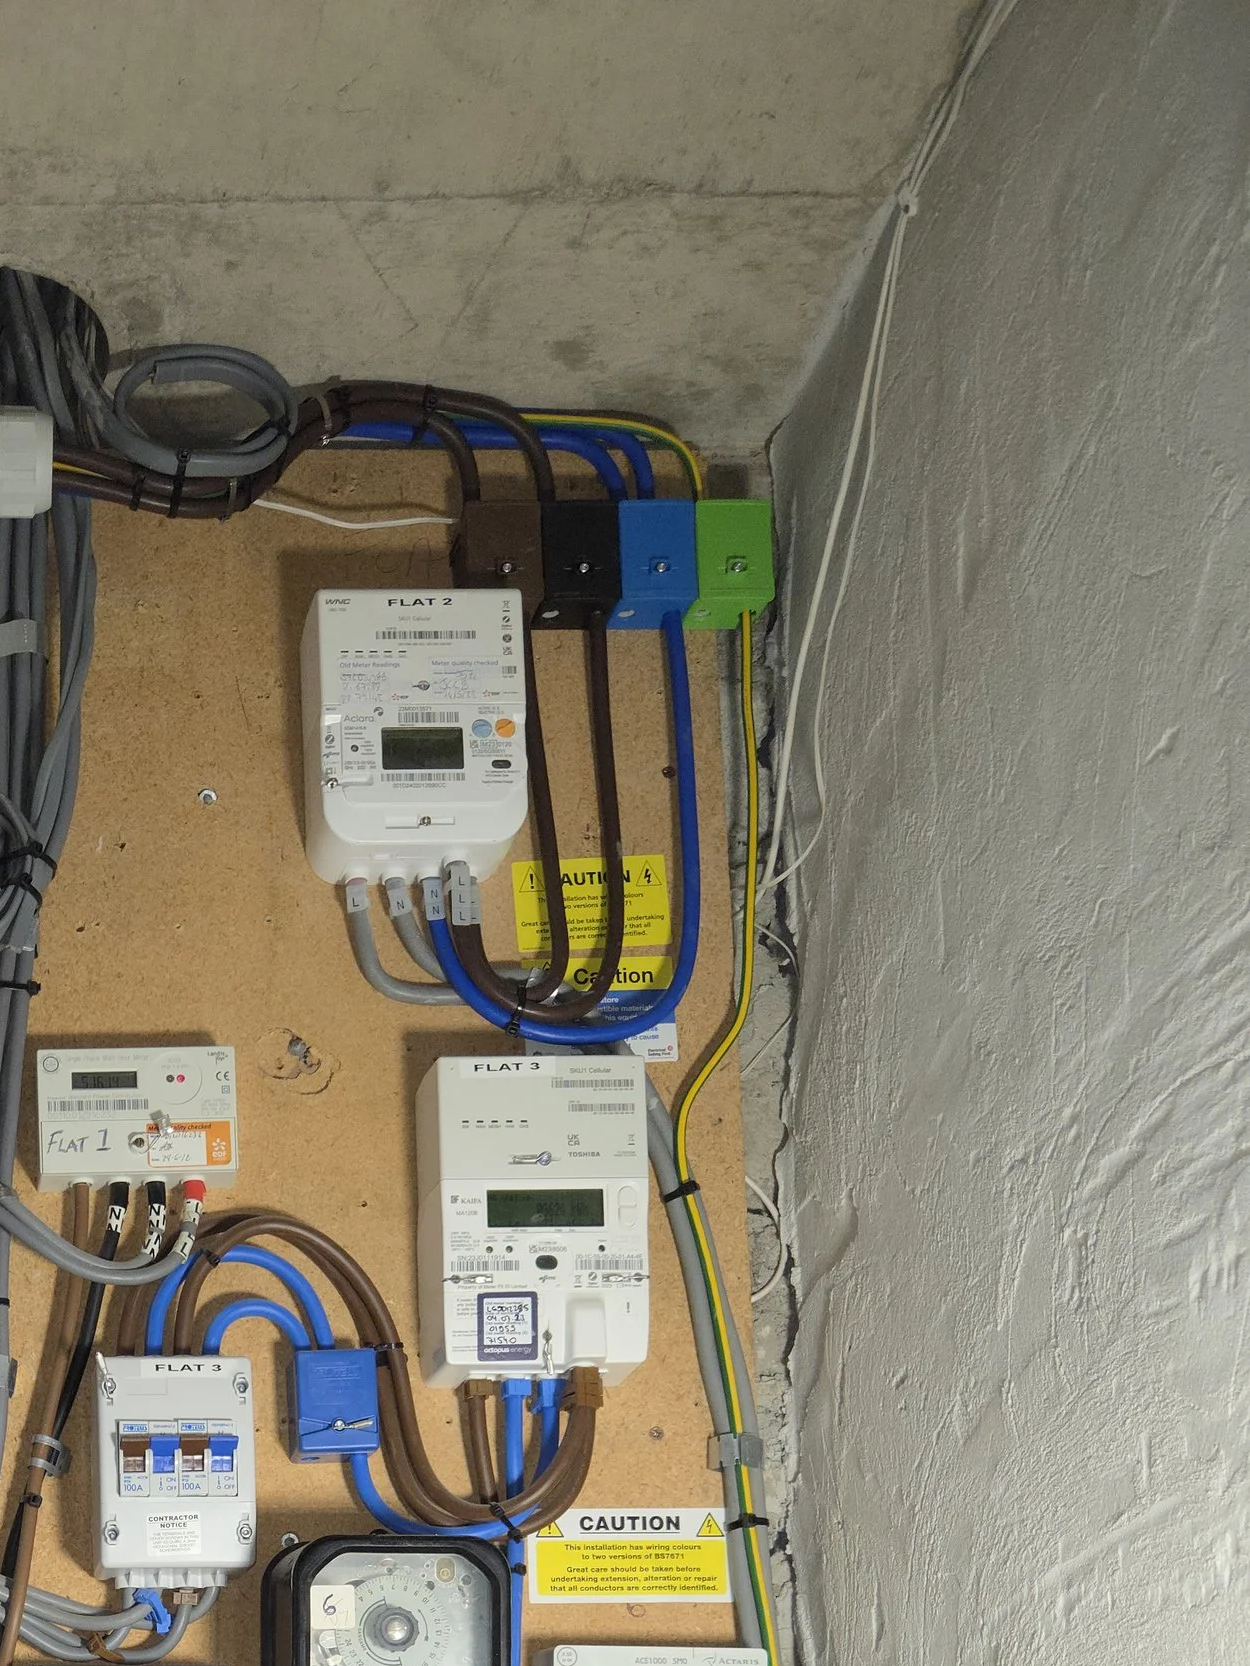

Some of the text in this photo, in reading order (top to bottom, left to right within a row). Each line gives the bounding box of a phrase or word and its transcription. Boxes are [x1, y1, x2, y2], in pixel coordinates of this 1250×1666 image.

[388, 598, 452, 606] FLAT 2
[451, 660, 472, 668] quality
[344, 714, 375, 723] Aclara
[458, 876, 465, 886] L
[561, 869, 631, 886] AUTIN
[430, 889, 438, 898] N
[352, 897, 360, 908] L
[396, 899, 405, 910] N
[432, 905, 440, 915] N
[459, 911, 466, 920] L
[573, 967, 654, 985] Cation
[474, 1062, 540, 1072] FLAT 3
[47, 1128, 111, 1154] FLAT 1
[155, 1364, 222, 1372] FLAT 3
[123, 1483, 144, 1492] 100A
[182, 1482, 202, 1491] 100A
[148, 1514, 199, 1522] CONTRACTOR
[579, 1515, 681, 1531] CAUTION
[551, 1575, 598, 1583] undertaking
[600, 1575, 641, 1583] extension,
[694, 1575, 718, 1583] repair
[641, 1584, 677, 1593] correctly
[679, 1584, 718, 1592] identified.
[322, 1593, 337, 1616] 6
